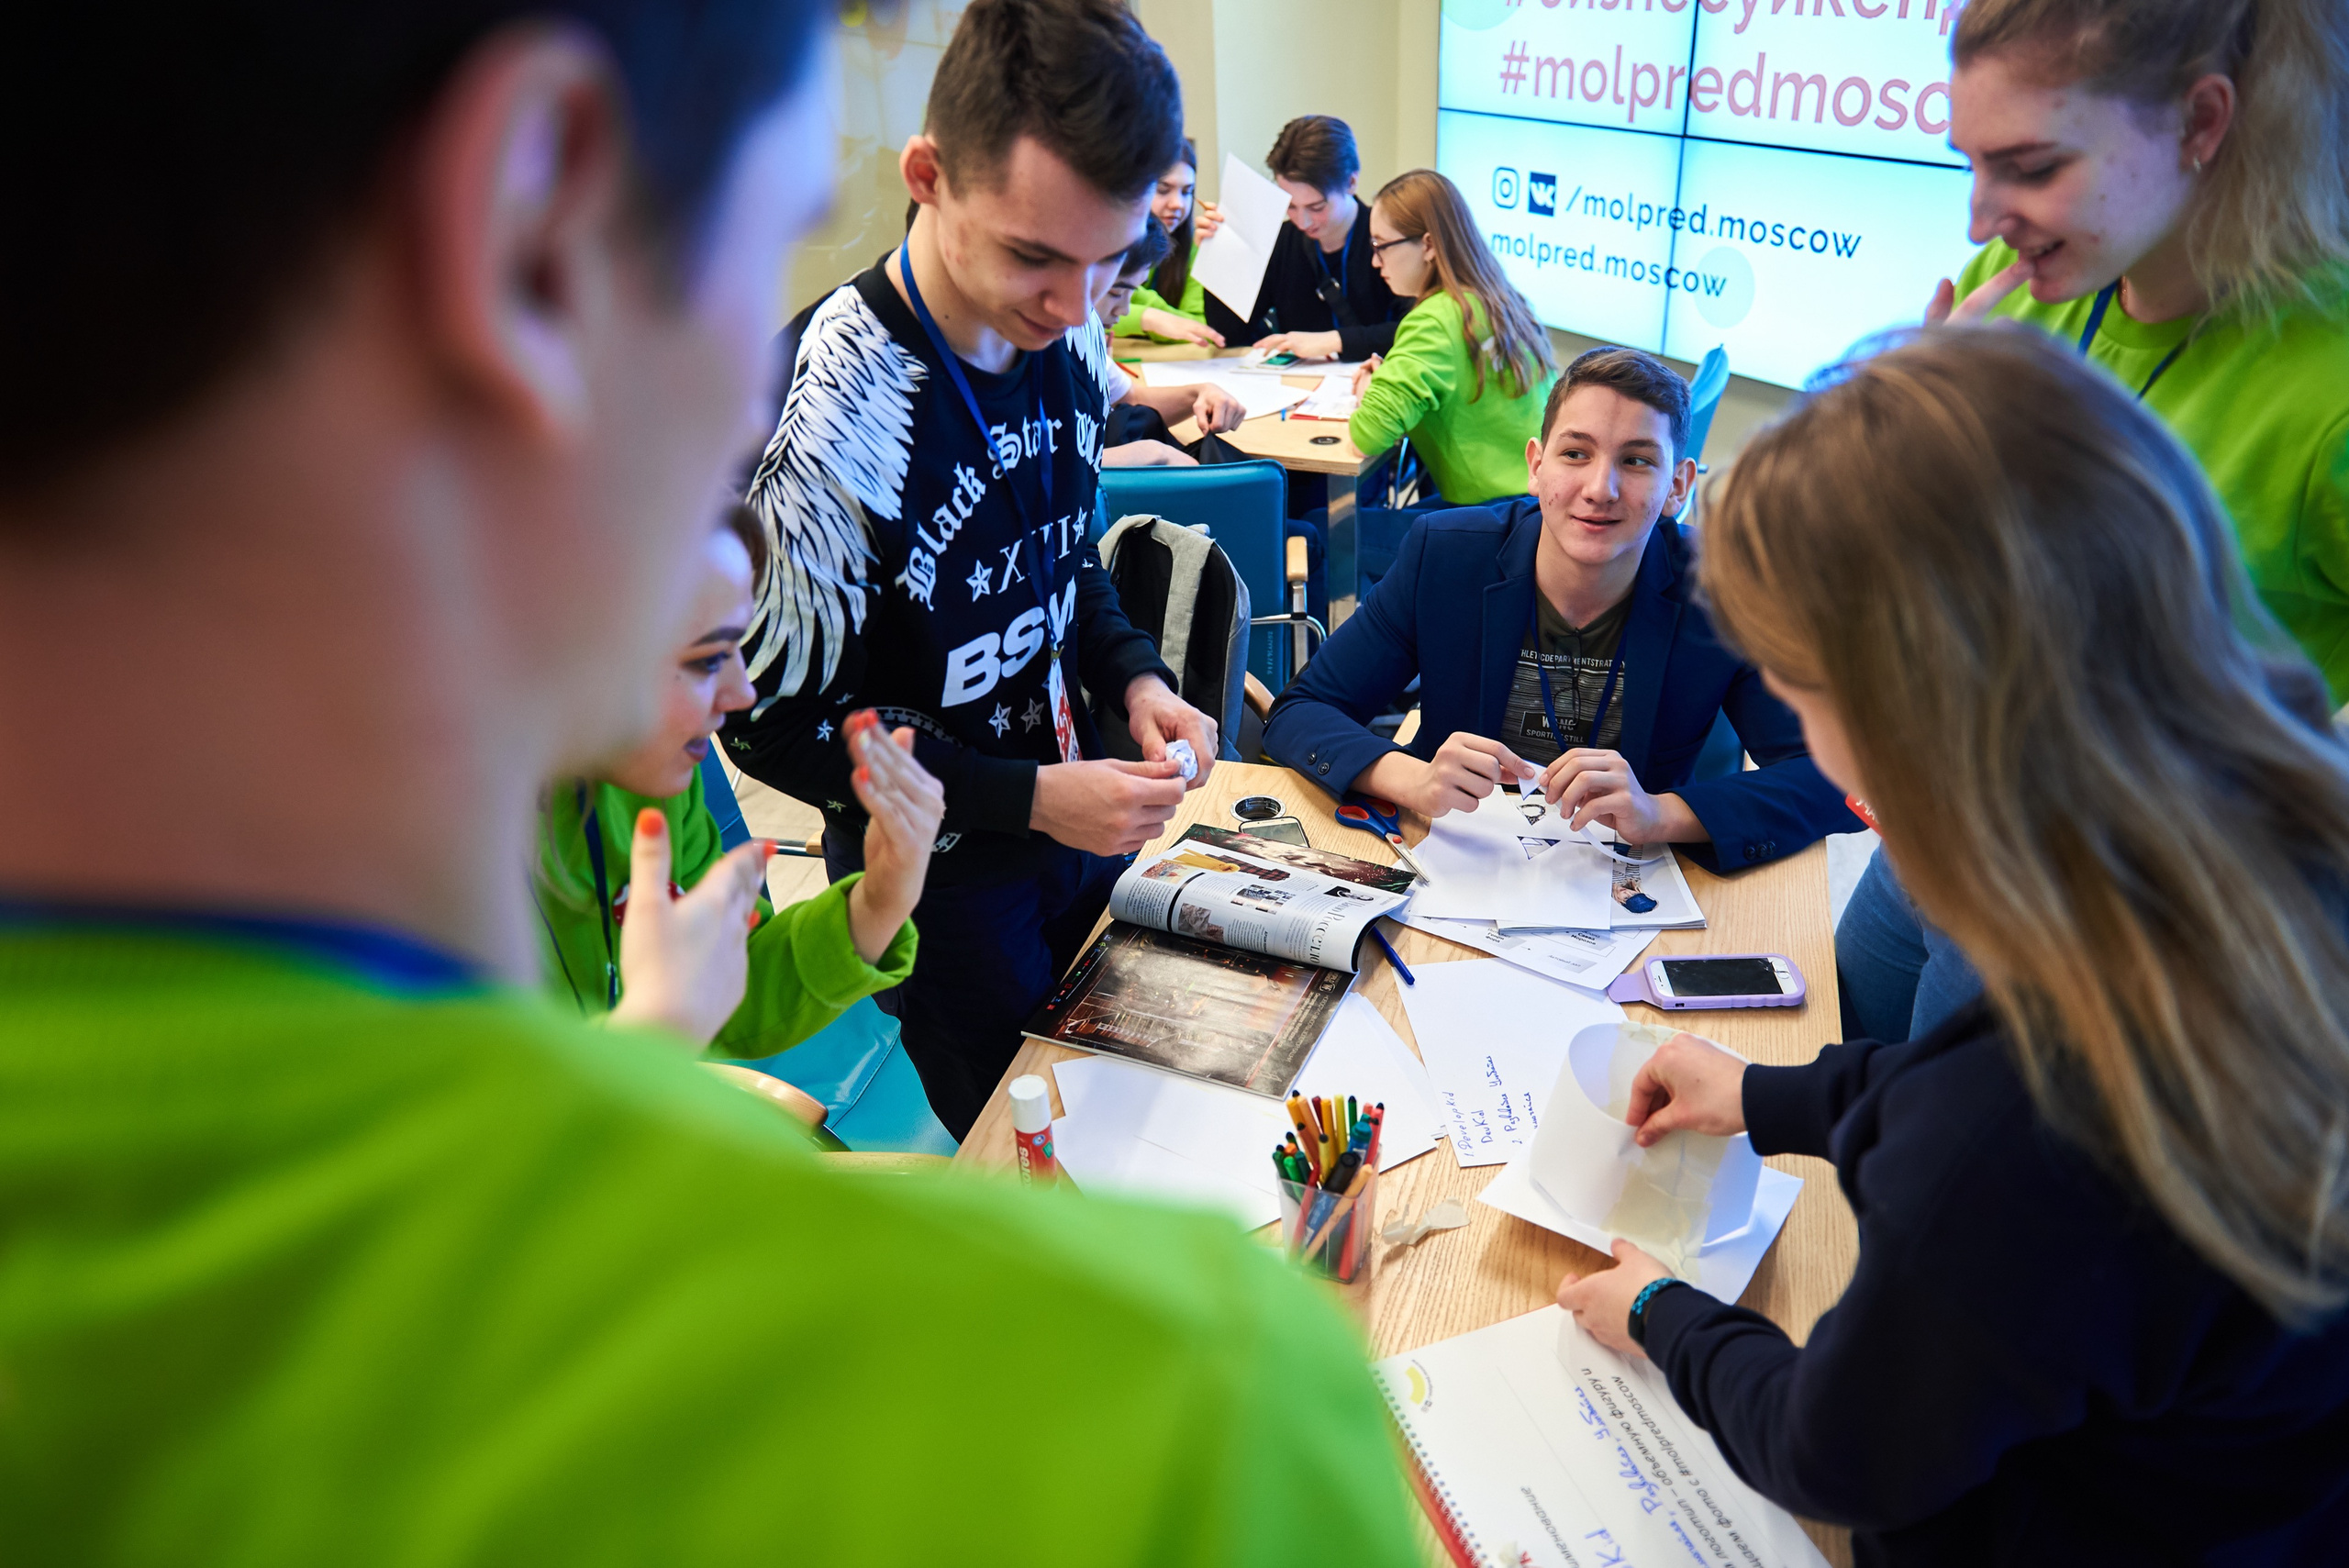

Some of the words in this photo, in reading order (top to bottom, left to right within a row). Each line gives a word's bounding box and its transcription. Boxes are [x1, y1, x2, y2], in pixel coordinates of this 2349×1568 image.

[1499, 40, 1952, 135] #molpredmosc
[1565, 186, 1863, 259] /molpred.moscow
[1491, 230, 1728, 298] molpred.moscow
[895, 461, 986, 612] Black
[987, 416, 1063, 480] Star
[1526, 728, 1561, 740] SPORTI
[1019, 1146, 1030, 1184] ores
[1588, 1377, 1625, 1419] фигуру
[1611, 1375, 1693, 1477] #molpredmoscow
[1620, 1421, 1673, 1486] объемную
[1520, 1485, 1580, 1568] именование
[1677, 1499, 1730, 1560] логотип
[1697, 1487, 1732, 1529] фото
[1584, 1528, 1633, 1568] Kid
